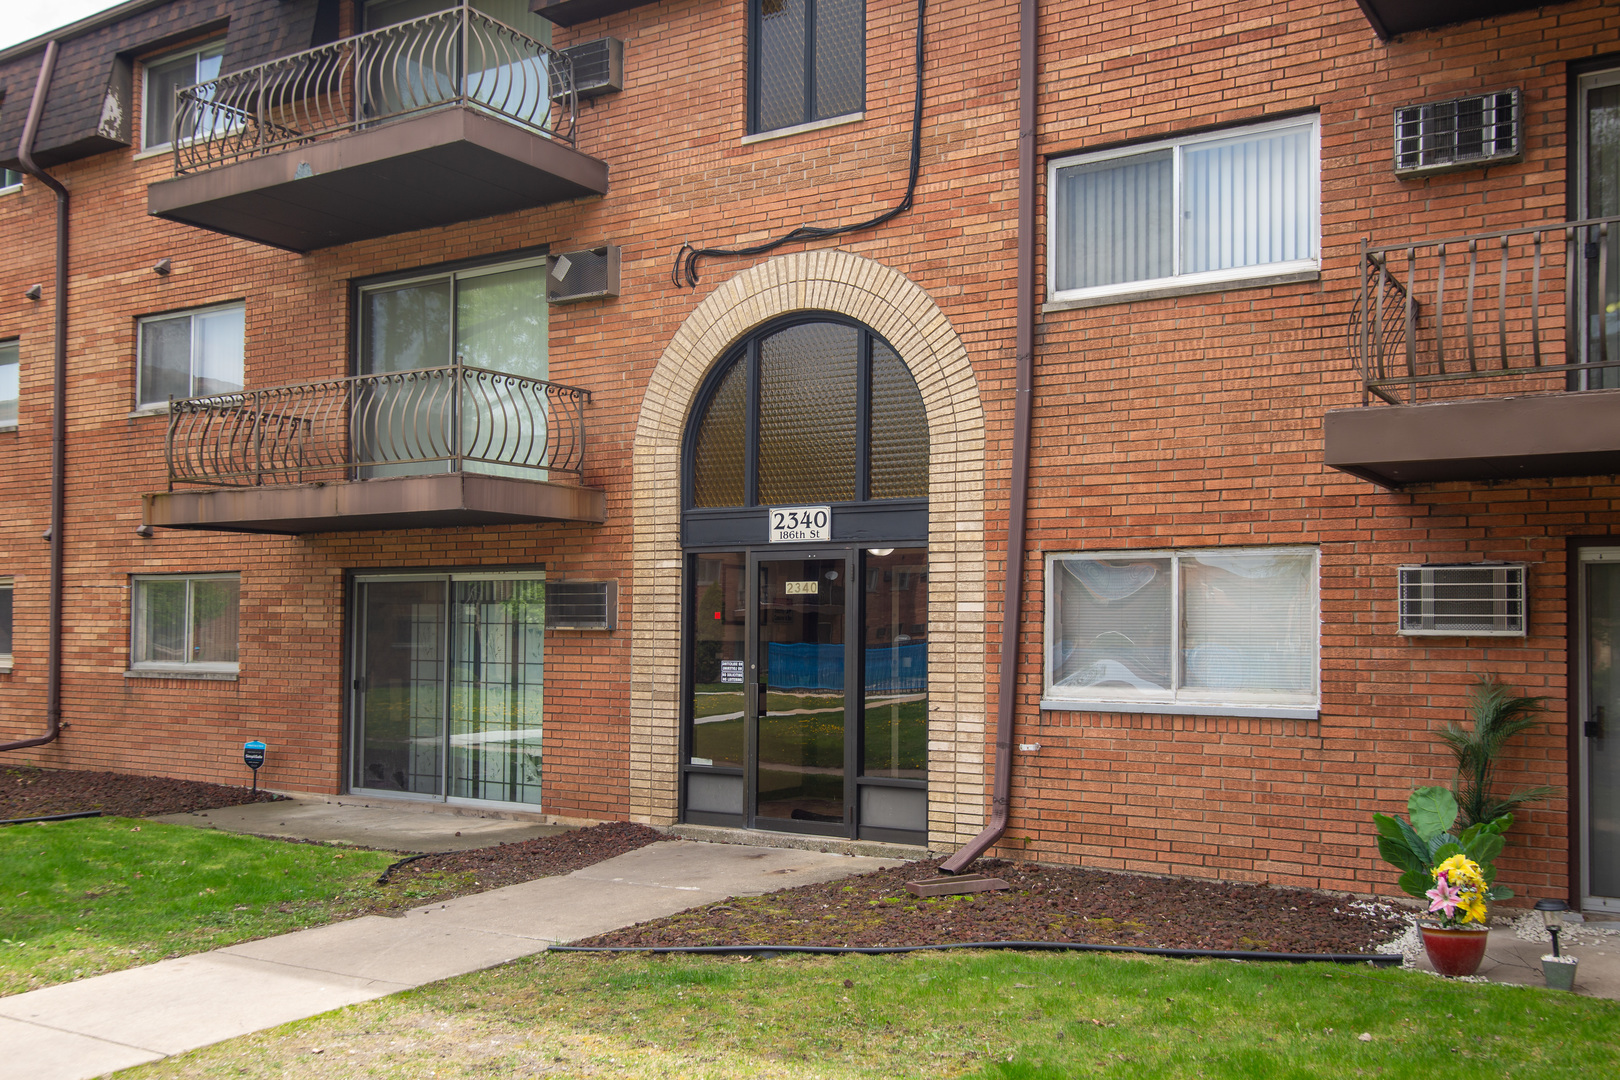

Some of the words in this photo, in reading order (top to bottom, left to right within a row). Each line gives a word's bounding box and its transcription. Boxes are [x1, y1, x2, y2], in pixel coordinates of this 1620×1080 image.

[774, 510, 828, 530] 2340
[780, 531, 806, 540] 186th
[810, 530, 820, 538] St
[787, 582, 817, 594] 2340
